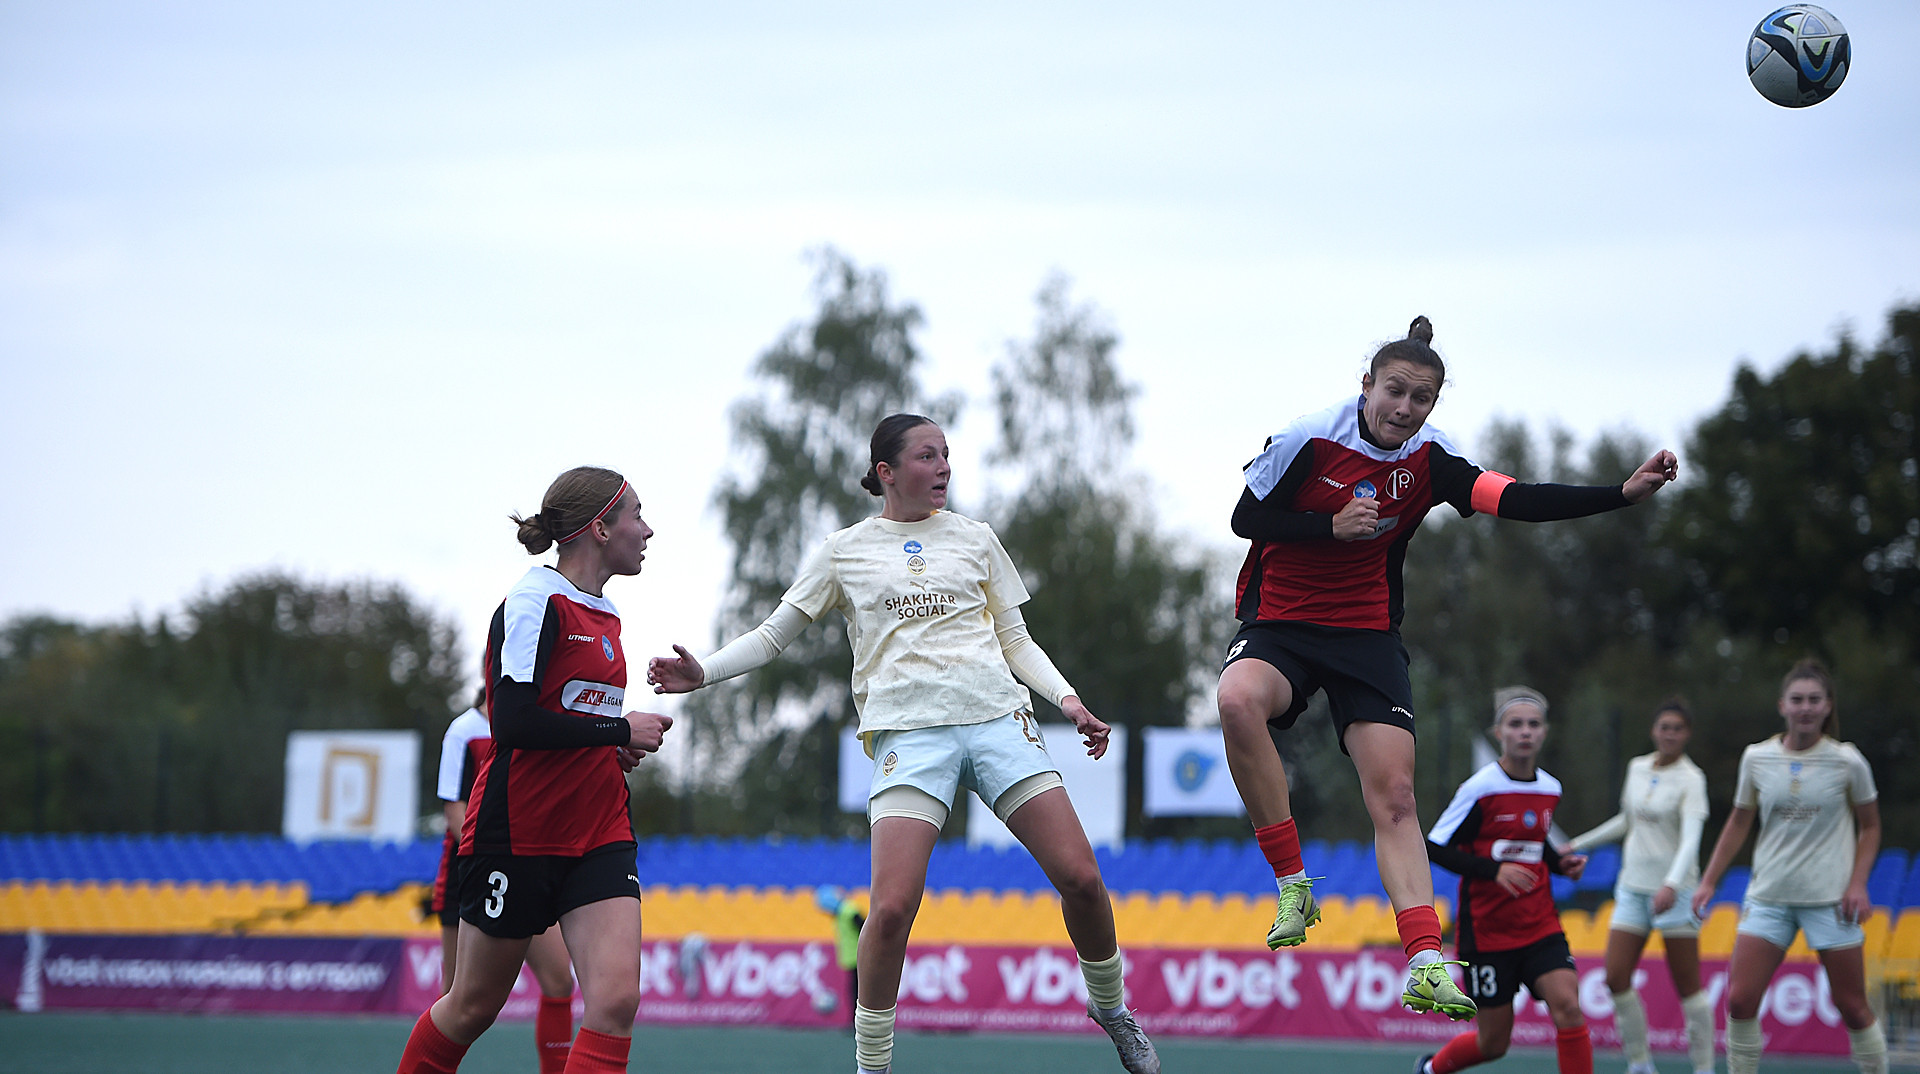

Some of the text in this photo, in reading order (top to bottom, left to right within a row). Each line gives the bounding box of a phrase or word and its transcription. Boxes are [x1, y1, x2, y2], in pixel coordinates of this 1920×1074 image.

[885, 593, 956, 610] SHAKHTAR
[898, 605, 947, 620] SOCIAL
[568, 634, 595, 642] UTMOST
[485, 871, 509, 918] 3
[703, 942, 827, 1001] vbet
[1160, 949, 1301, 1009] vbet
[1469, 963, 1498, 998] 13
